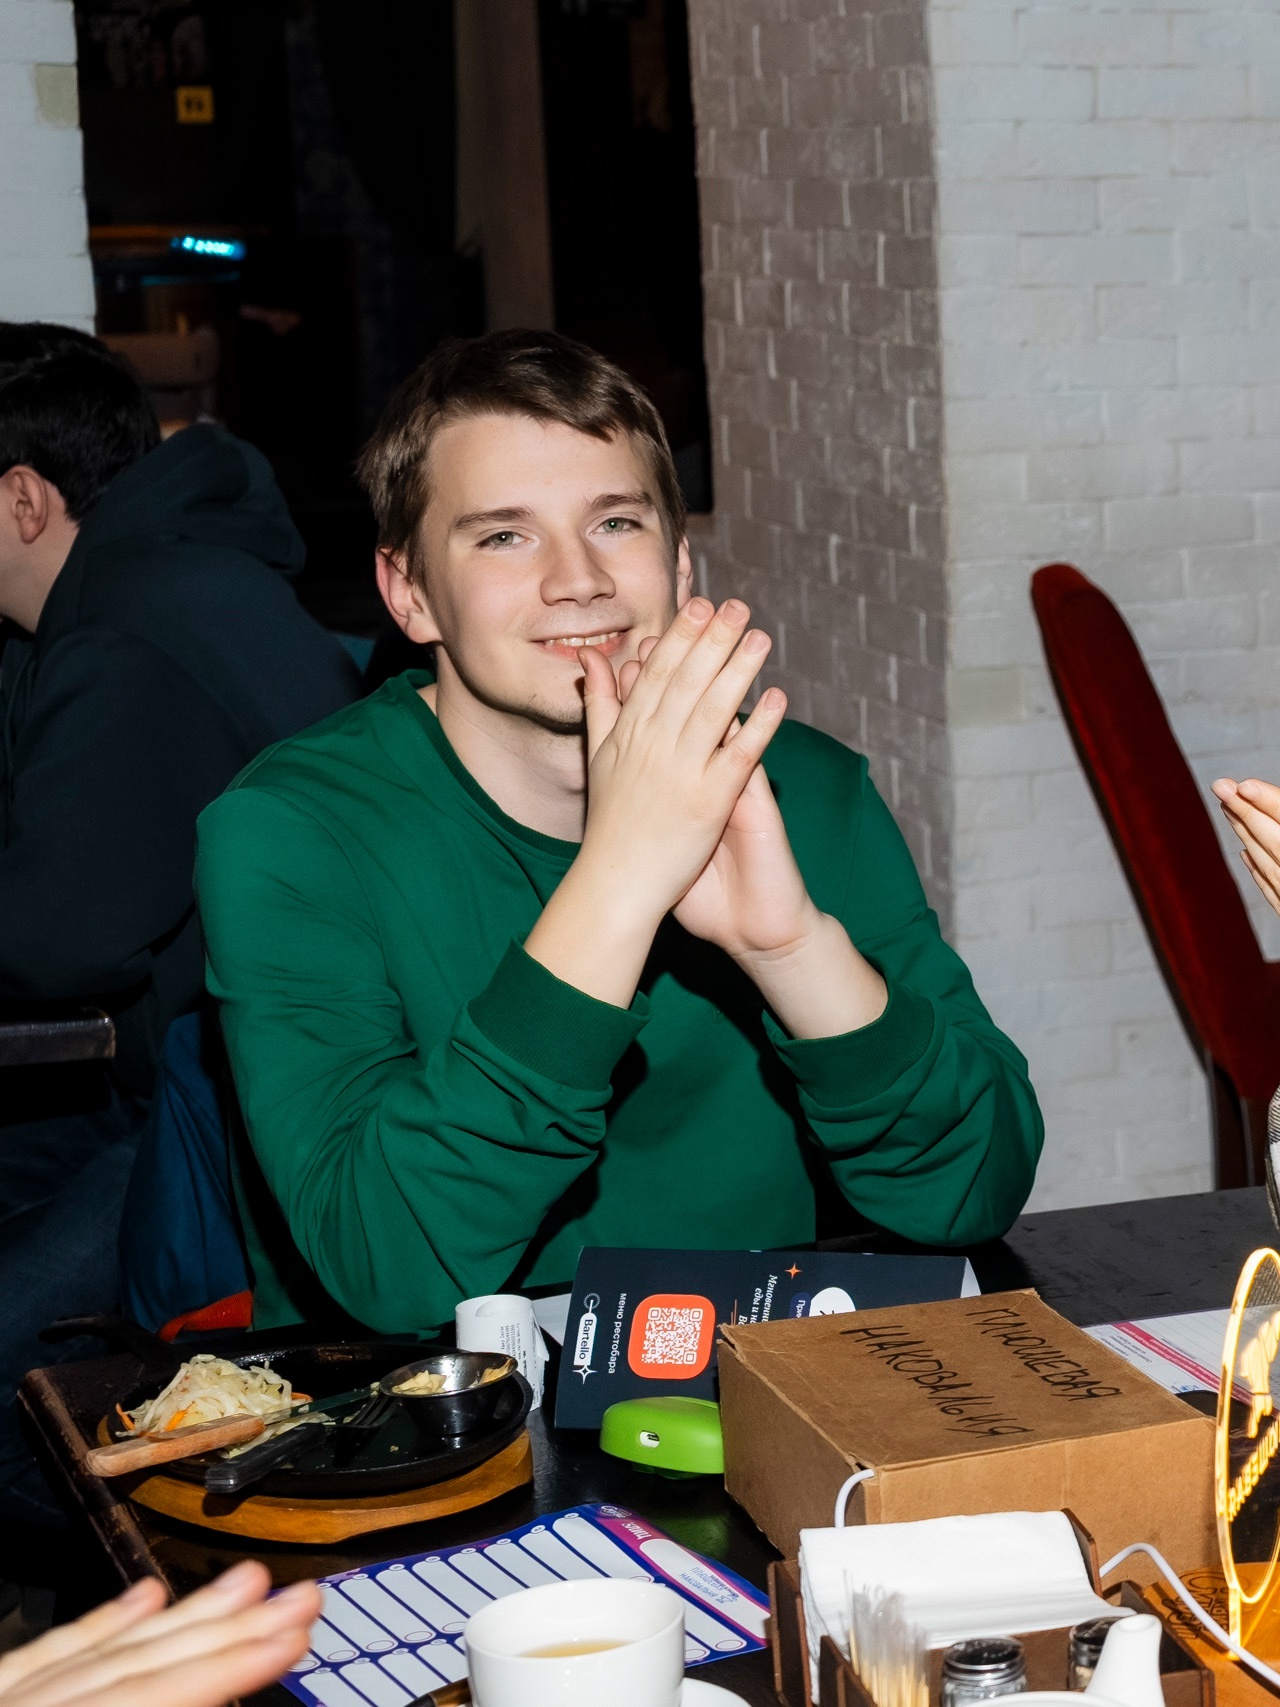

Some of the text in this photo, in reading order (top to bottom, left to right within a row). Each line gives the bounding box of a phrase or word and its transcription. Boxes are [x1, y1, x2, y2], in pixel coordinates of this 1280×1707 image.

[752, 1287, 764, 1306] еды
[579, 1319, 593, 1359] Bartello
[608, 1321, 622, 1373] рестобара
[966, 1308, 1123, 1402] ПЛЮШЕВАЯ
